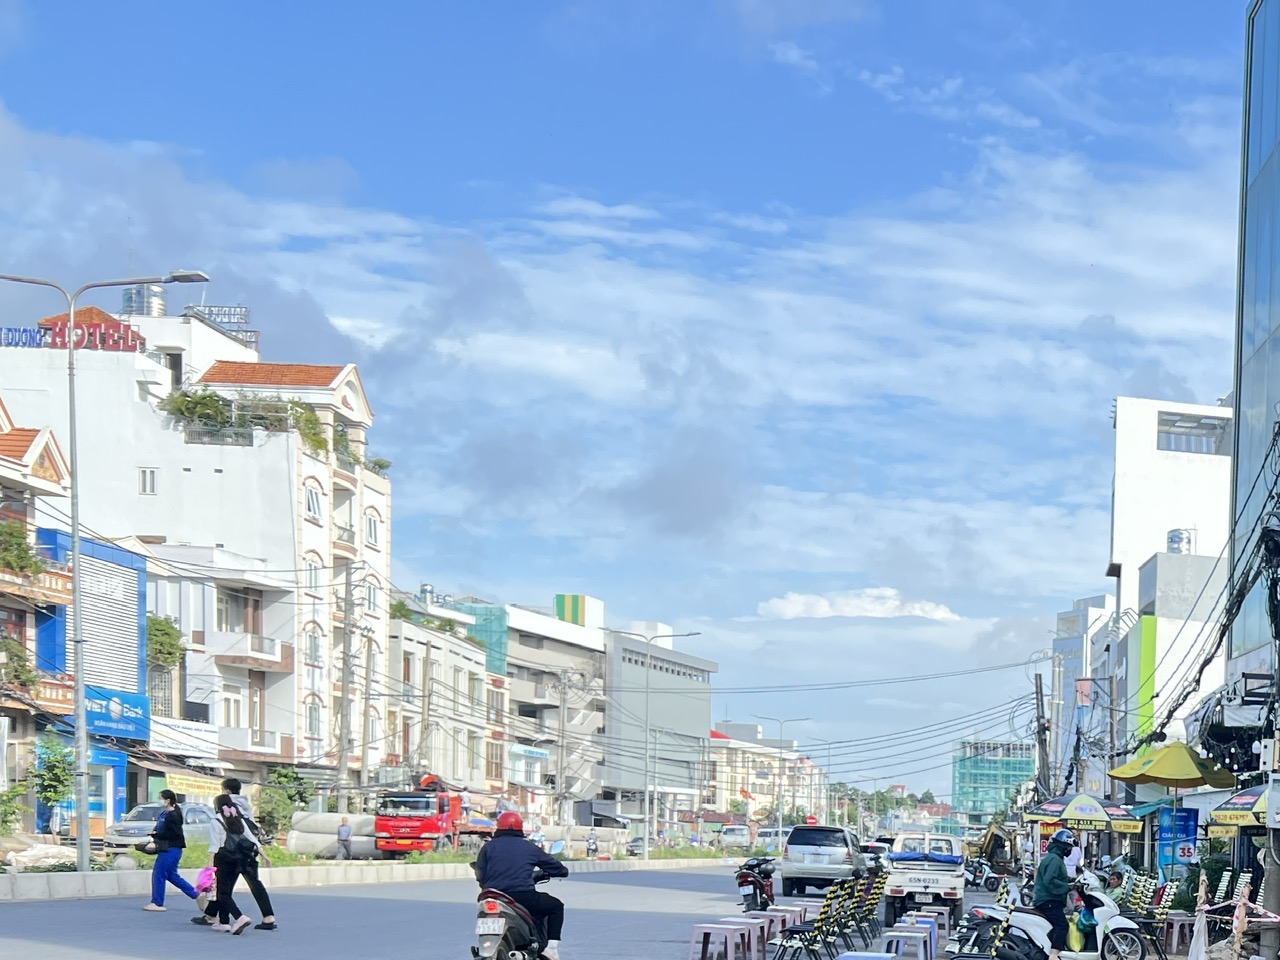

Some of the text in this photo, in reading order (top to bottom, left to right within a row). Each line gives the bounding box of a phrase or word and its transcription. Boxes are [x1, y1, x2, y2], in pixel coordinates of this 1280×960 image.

[51, 321, 139, 352] HOTEL
[123, 704, 143, 718] Bank
[1179, 847, 1193, 857] 35
